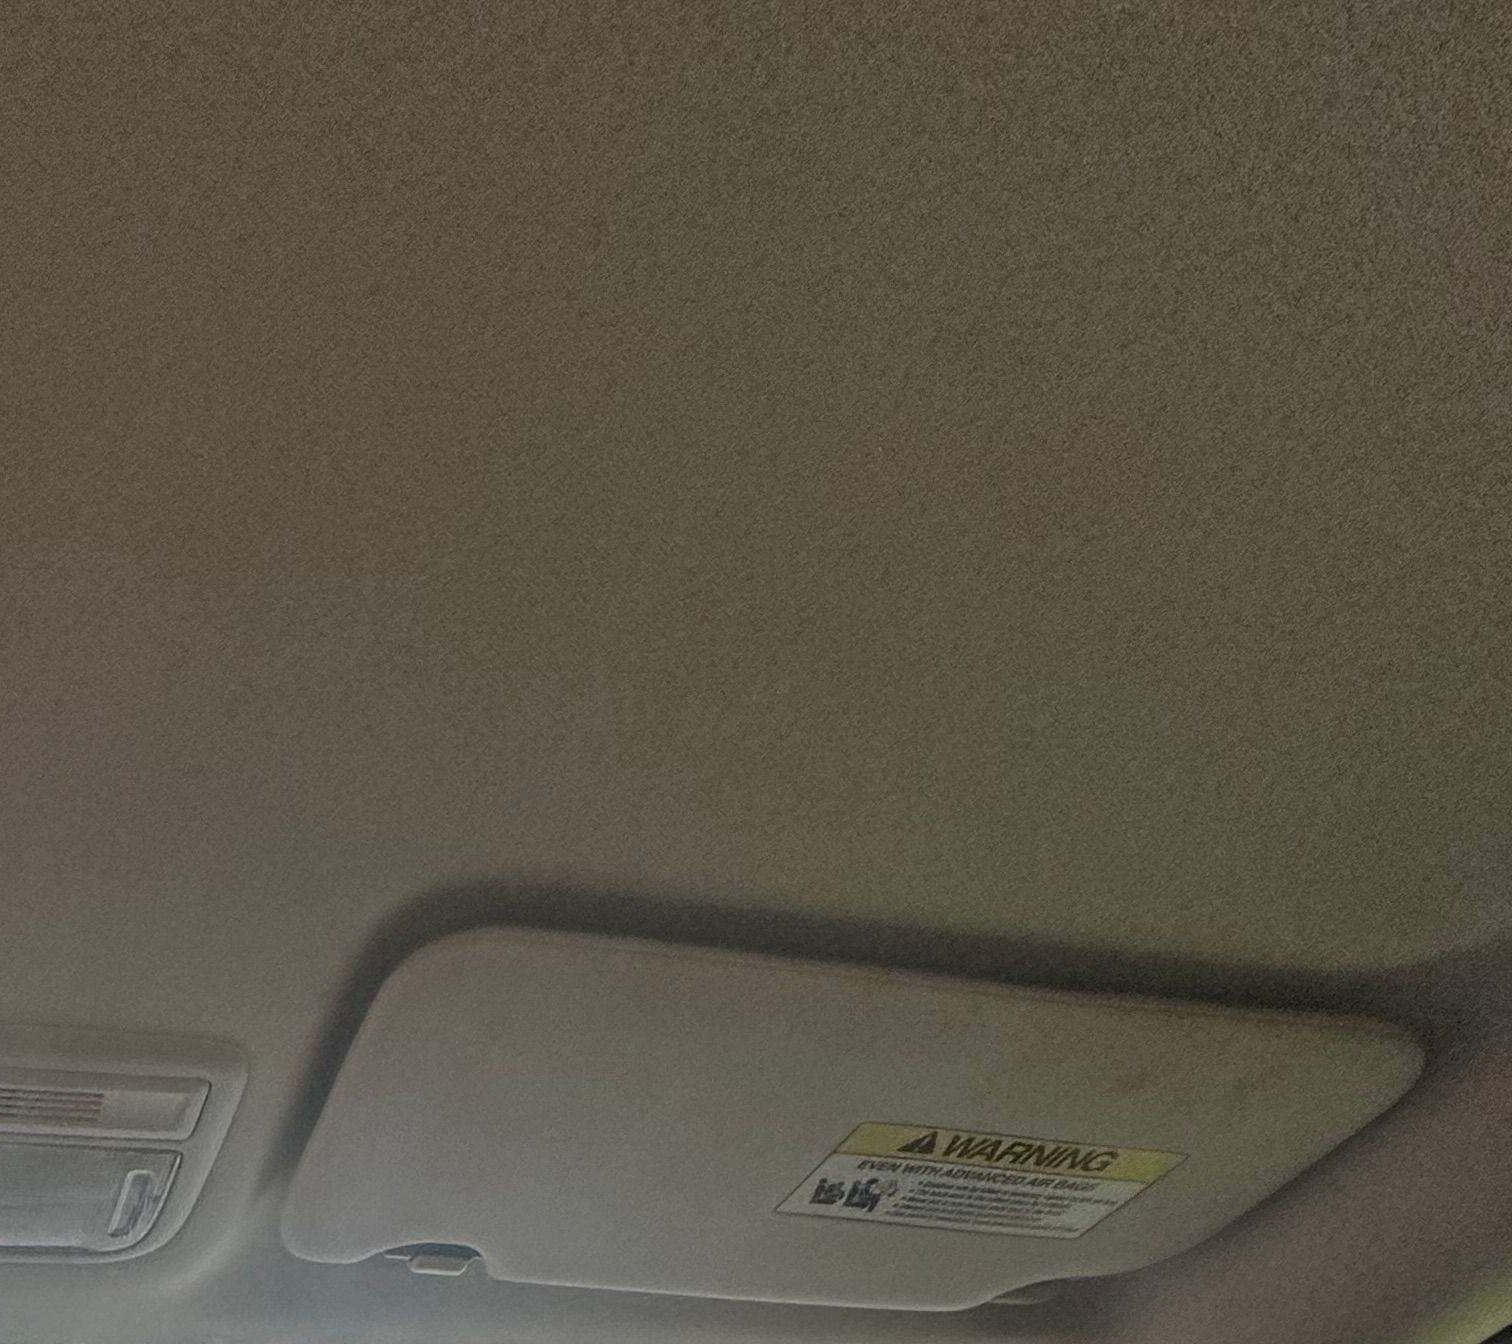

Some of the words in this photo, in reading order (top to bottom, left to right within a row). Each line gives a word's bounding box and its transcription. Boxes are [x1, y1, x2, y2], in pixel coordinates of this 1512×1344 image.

[942, 1134, 1119, 1172] WARNING
[857, 1160, 902, 1172] EVEN
[903, 1164, 939, 1177] WITH
[944, 1167, 1025, 1186] ADVANCED
[1024, 1177, 1052, 1189] AIR
[1050, 1179, 1100, 1193] BAGS
